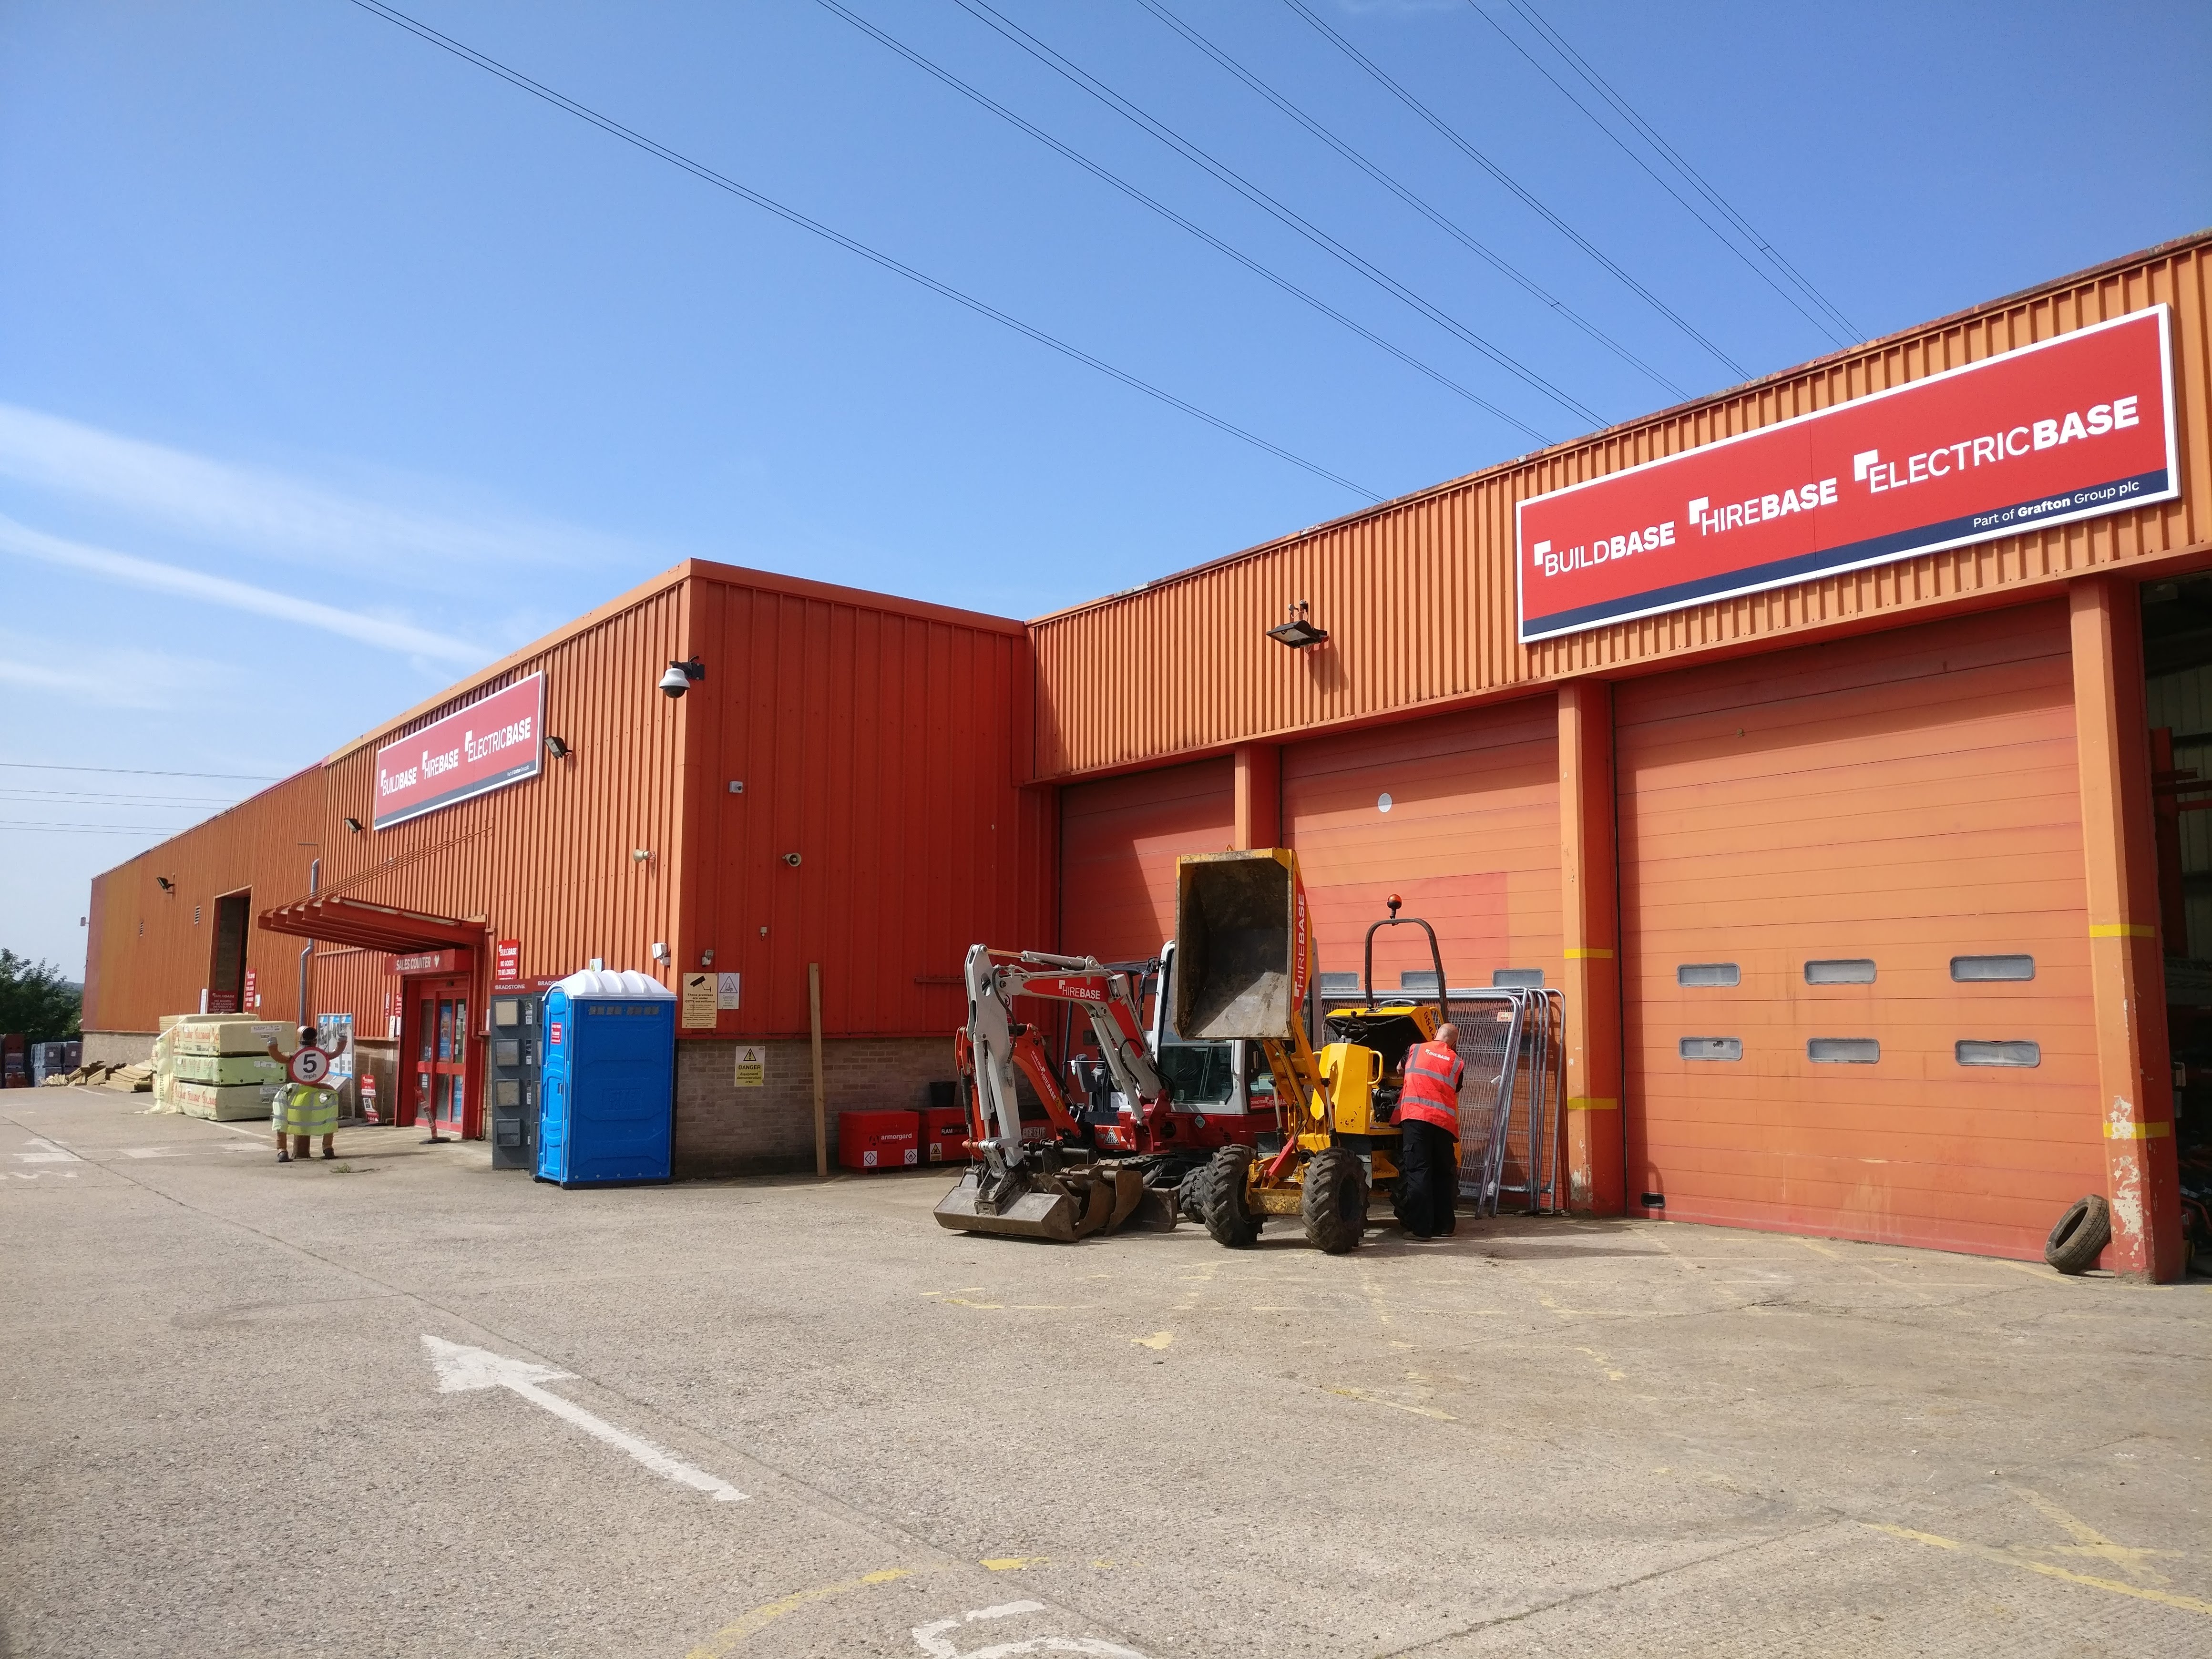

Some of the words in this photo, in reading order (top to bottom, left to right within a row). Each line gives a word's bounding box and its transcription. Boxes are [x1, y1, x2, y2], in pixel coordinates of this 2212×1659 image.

[1545, 521, 1675, 577] BUILDBASE
[1702, 477, 1838, 536] HIREBASE
[1870, 395, 2139, 493] ELECTRICBASE
[1974, 513, 1999, 527] Part
[2002, 509, 2015, 521] of
[2017, 497, 2070, 517] Grafton
[2074, 488, 2116, 504] Group
[2119, 481, 2140, 496] plc
[382, 767, 417, 796] BUILDBASE
[424, 748, 459, 779] HIREBASE
[468, 717, 531, 762] ELECTRICBASE
[500, 947, 517, 956] BUILDBASE
[1297, 893, 1305, 988] HIREBASE
[396, 958, 410, 971] SALES
[410, 956, 431, 969] COUNTER
[1062, 985, 1101, 1000] HIREBASE
[303, 1054, 317, 1073] 5
[1427, 1051, 1451, 1061] HIREBASE
[1040, 1071, 1057, 1101] HIREBASE
